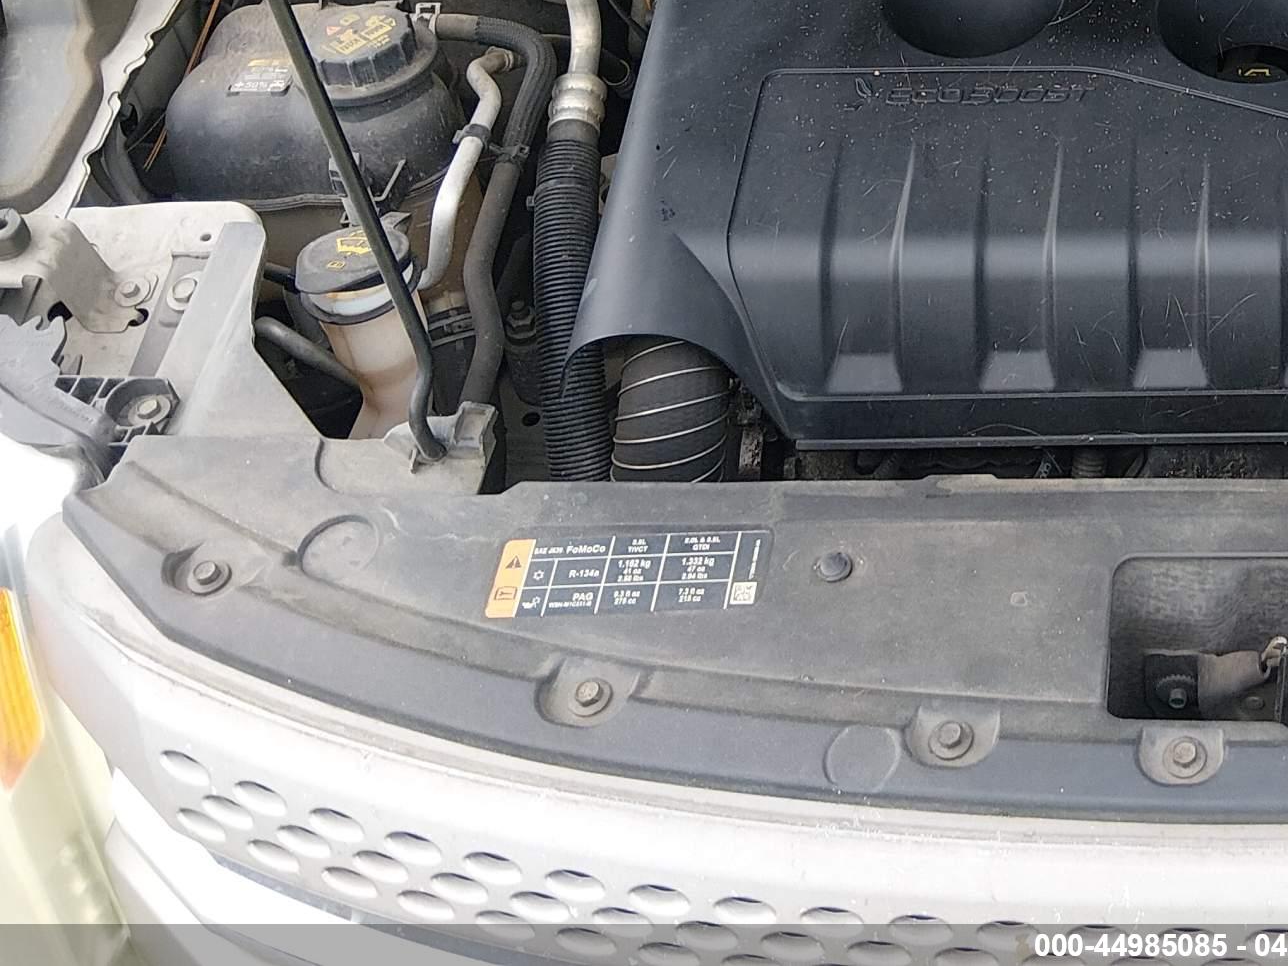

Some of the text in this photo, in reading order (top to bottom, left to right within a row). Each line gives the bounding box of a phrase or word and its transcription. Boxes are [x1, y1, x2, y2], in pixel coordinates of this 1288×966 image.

[566, 545, 606, 554] FoMoCo
[640, 559, 651, 569] kg
[704, 557, 715, 566] kg
[569, 569, 600, 578] R-134a
[572, 592, 594, 601] PAG
